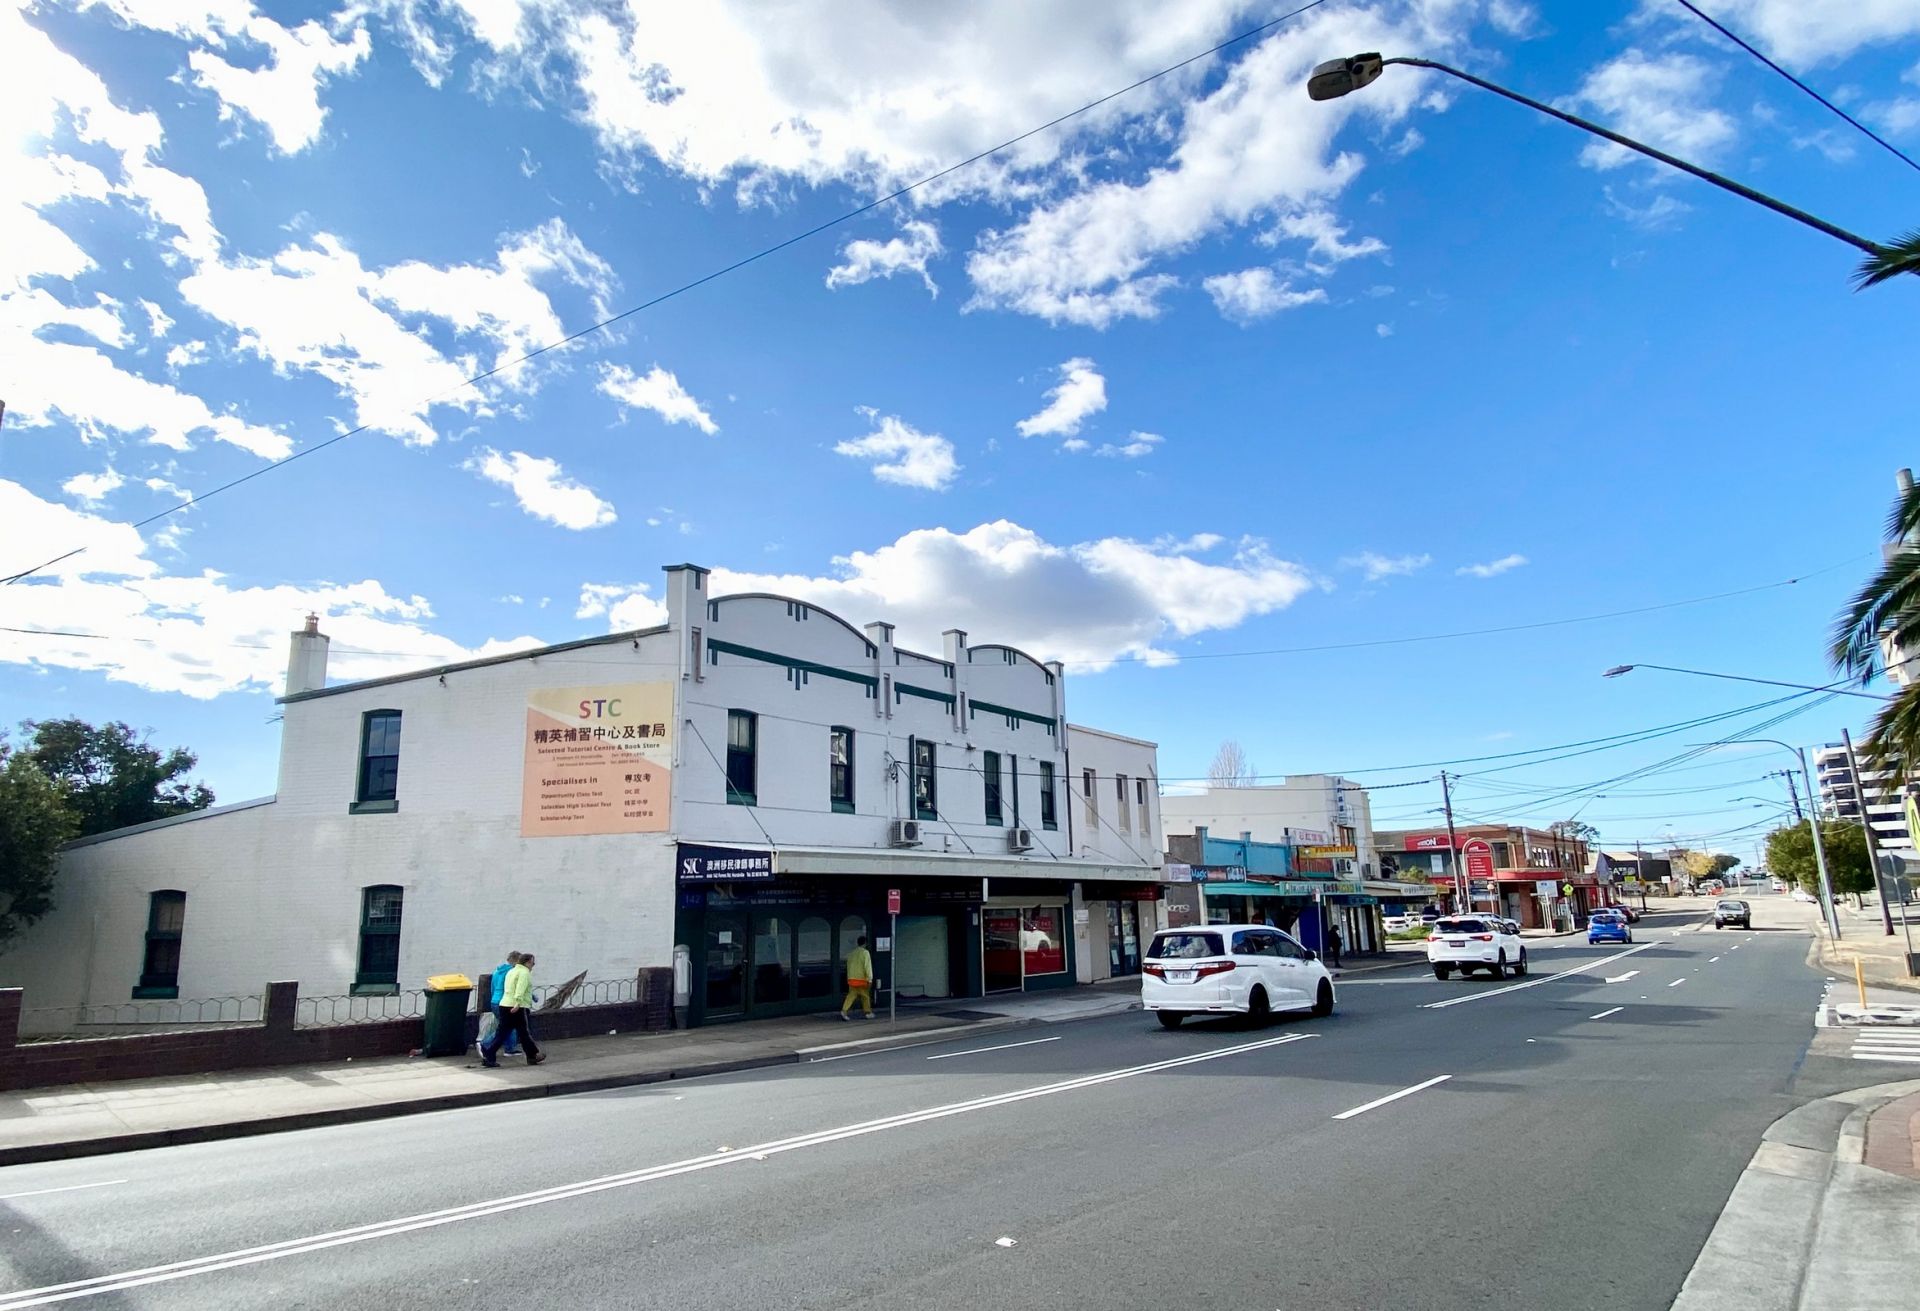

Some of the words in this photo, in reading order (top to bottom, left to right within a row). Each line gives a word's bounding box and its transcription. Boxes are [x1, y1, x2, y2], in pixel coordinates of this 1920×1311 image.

[579, 699, 622, 719] STC
[534, 723, 666, 744] 精英補習中心及書局
[541, 776, 587, 787] Specialises
